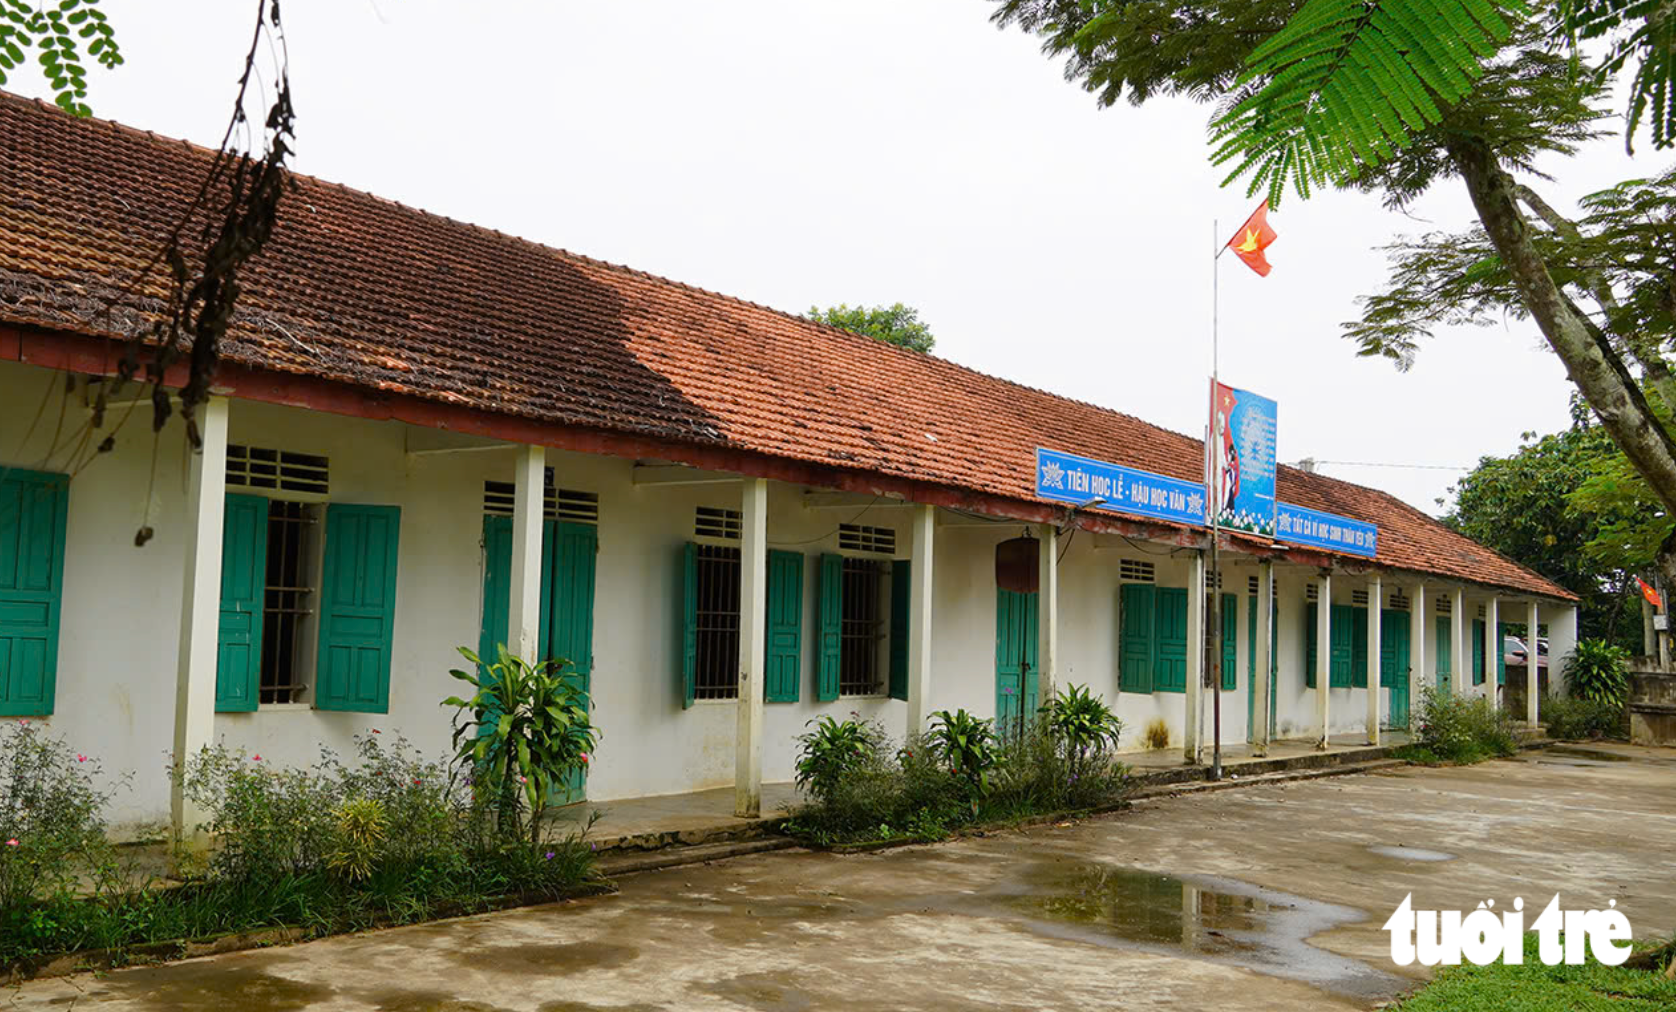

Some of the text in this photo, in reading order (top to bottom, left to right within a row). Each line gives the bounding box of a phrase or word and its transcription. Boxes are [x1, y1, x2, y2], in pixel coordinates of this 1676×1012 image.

[1067, 468, 1089, 492] TIÊN
[1112, 473, 1124, 499] LỄ
[1131, 481, 1149, 507] HẬU
[1150, 487, 1168, 509] HỌC
[1169, 489, 1186, 511] VĂN
